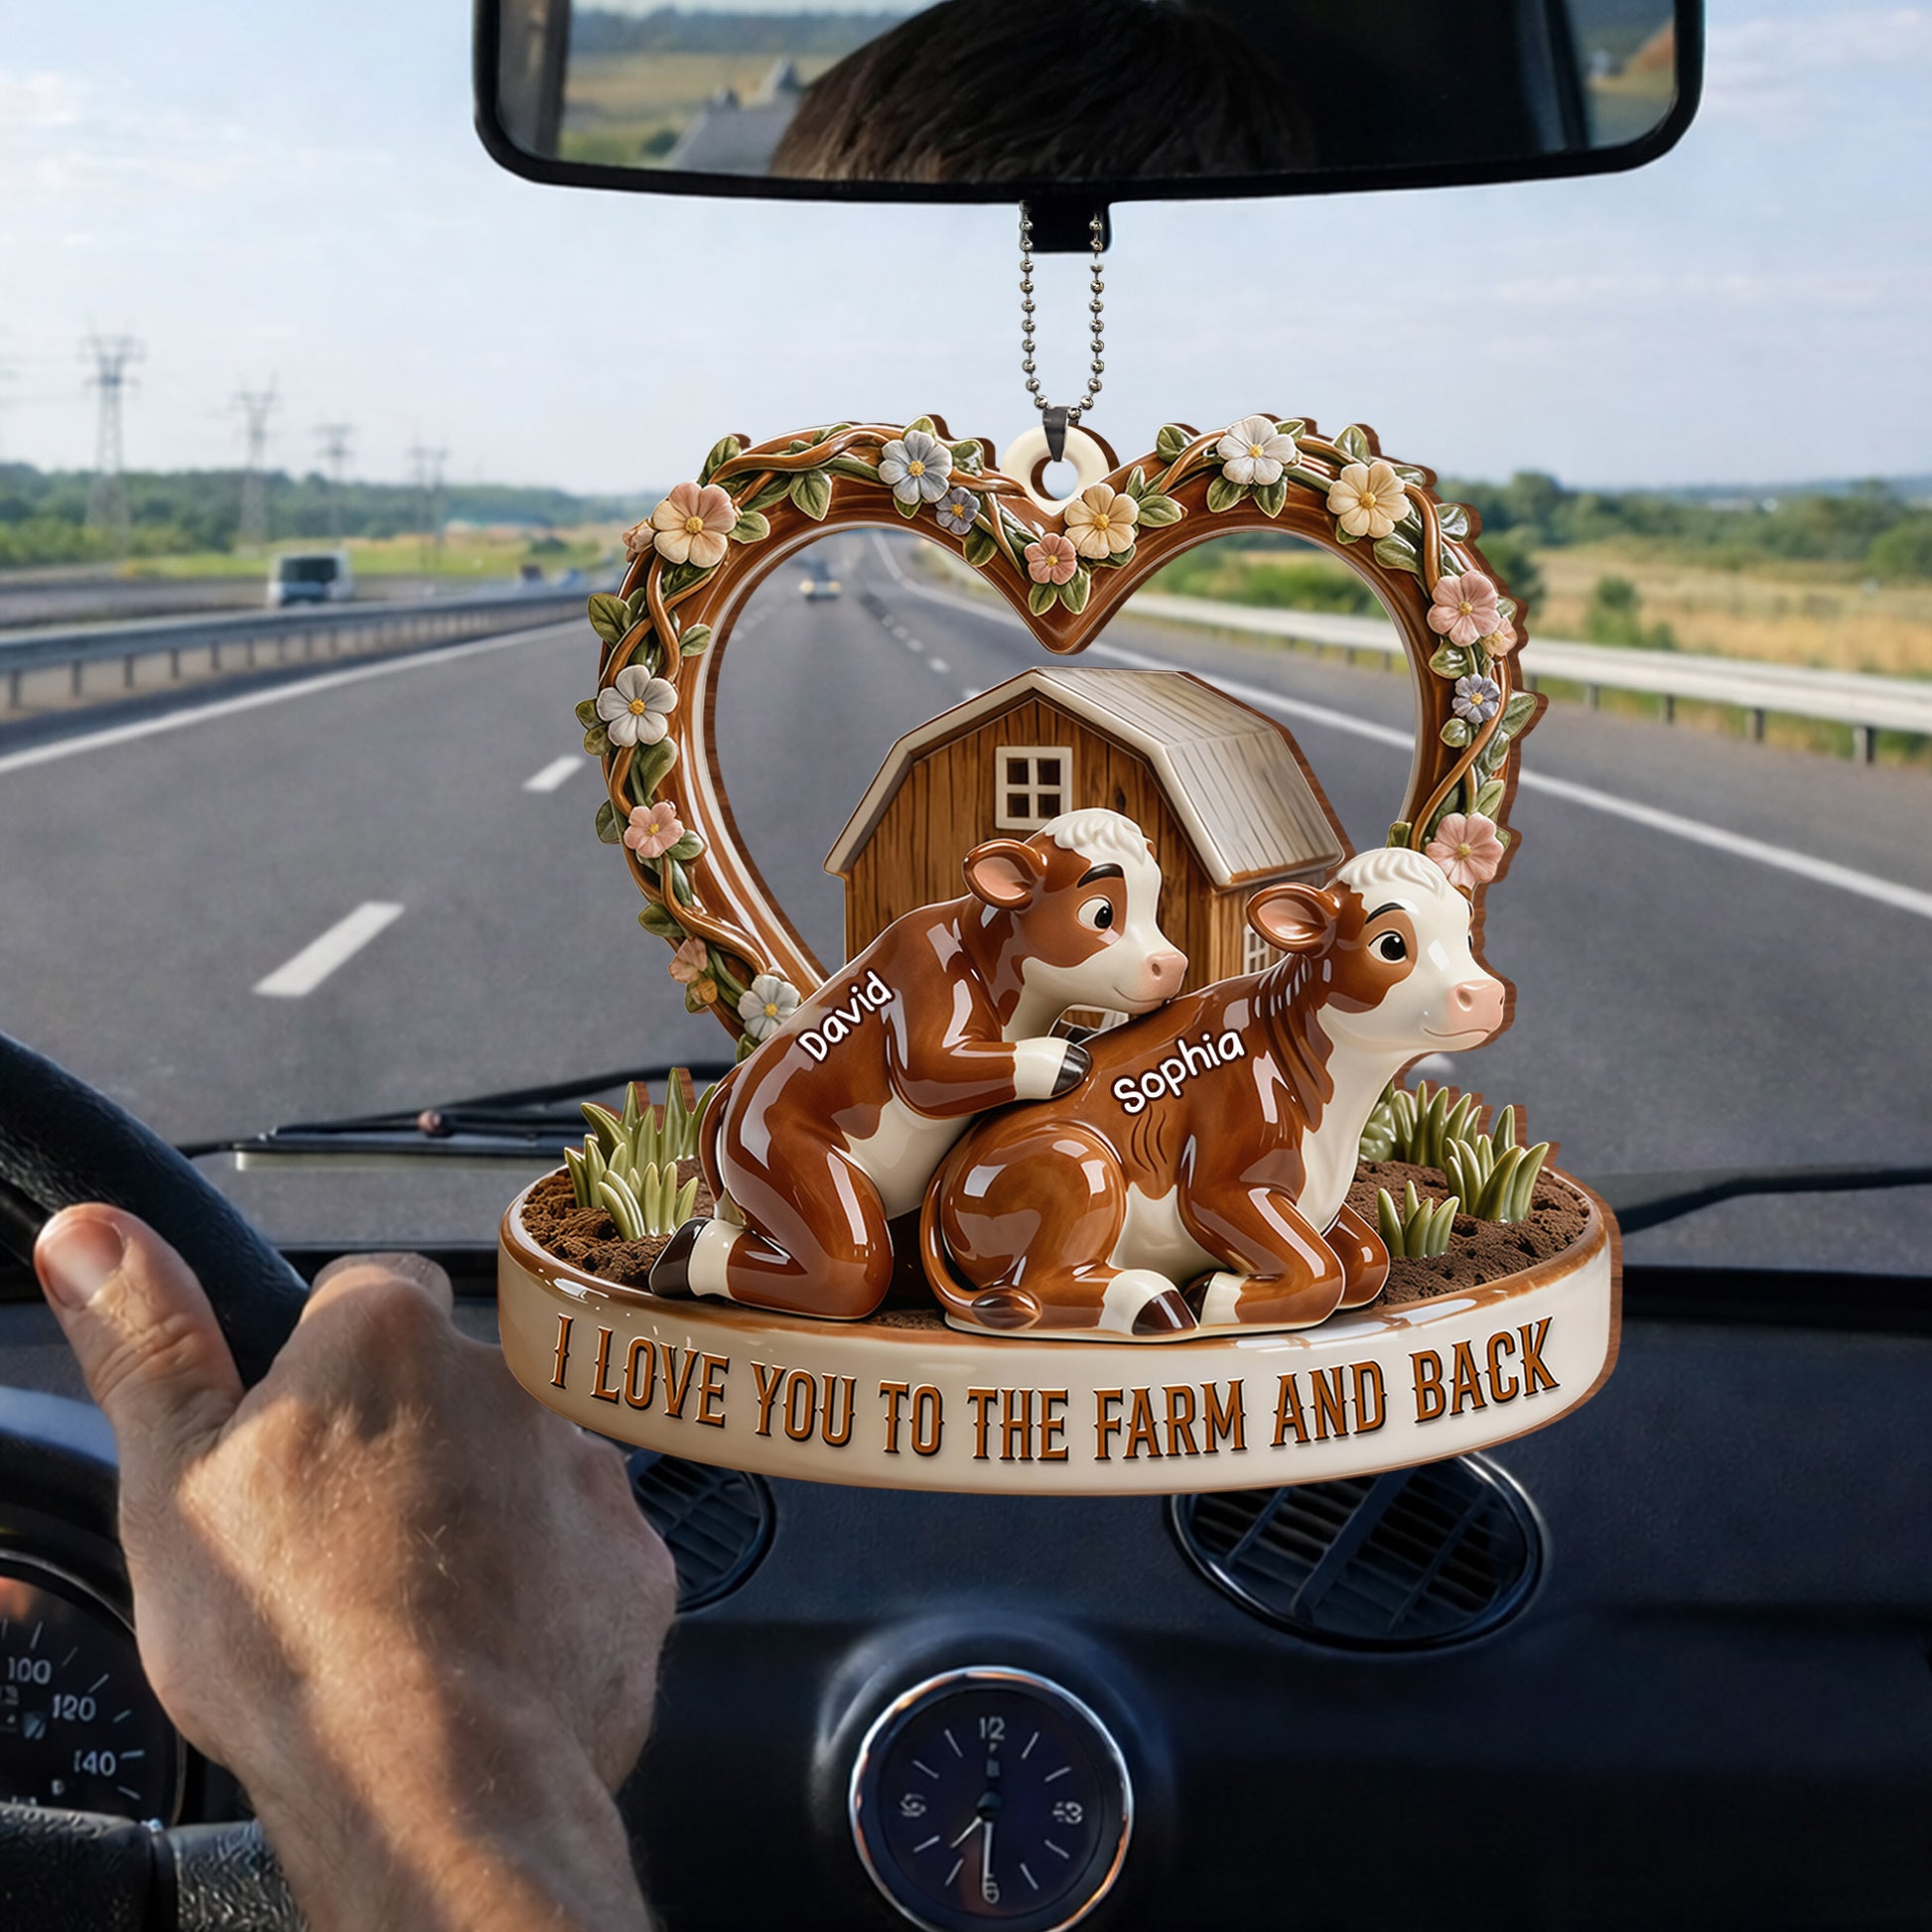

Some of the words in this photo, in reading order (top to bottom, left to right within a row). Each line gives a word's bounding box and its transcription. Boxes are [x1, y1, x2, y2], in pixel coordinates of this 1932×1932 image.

[797, 970, 893, 1062] David
[1113, 1031, 1246, 1114] Sophia
[550, 1313, 575, 1389] I
[590, 1326, 731, 1428] LOVE
[750, 1359, 858, 1449] YOU
[878, 1380, 946, 1457] TO
[966, 1386, 1070, 1462] THE
[1093, 1377, 1248, 1461] FARM
[1270, 1359, 1388, 1449] AND
[1408, 1315, 1561, 1425] BACK
[7, 1656, 52, 1685] 100
[52, 1694, 96, 1722] 120
[978, 1717, 1006, 1740] 12
[72, 1750, 117, 1777] 140
